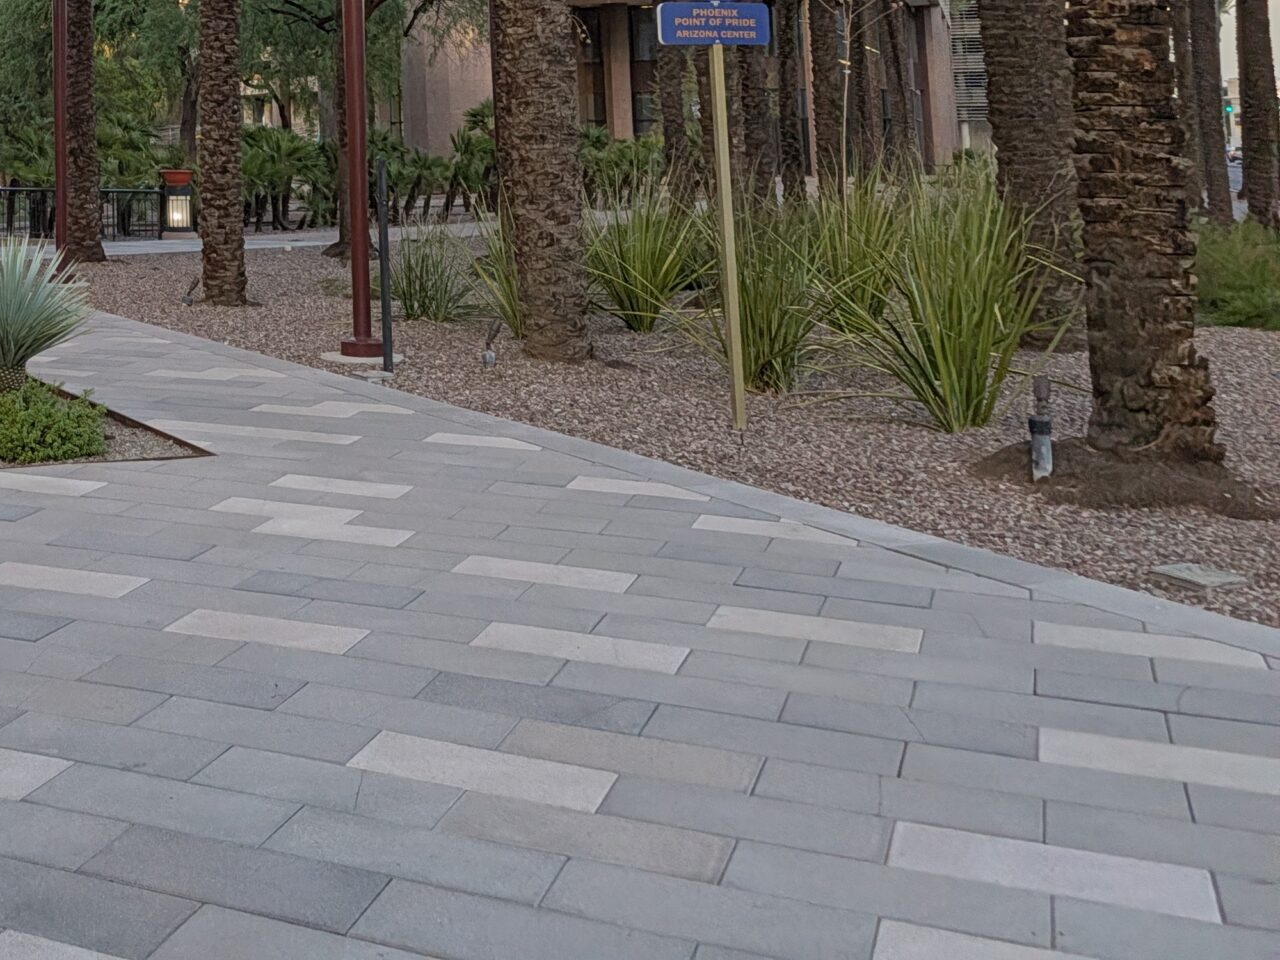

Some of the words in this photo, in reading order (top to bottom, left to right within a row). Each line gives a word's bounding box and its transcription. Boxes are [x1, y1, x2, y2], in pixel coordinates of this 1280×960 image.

[674, 17, 706, 26] POINT
[709, 18, 722, 26] OF
[725, 18, 756, 27] PRIDE
[676, 30, 719, 38] ARIZONA
[721, 30, 756, 39] CENTER
